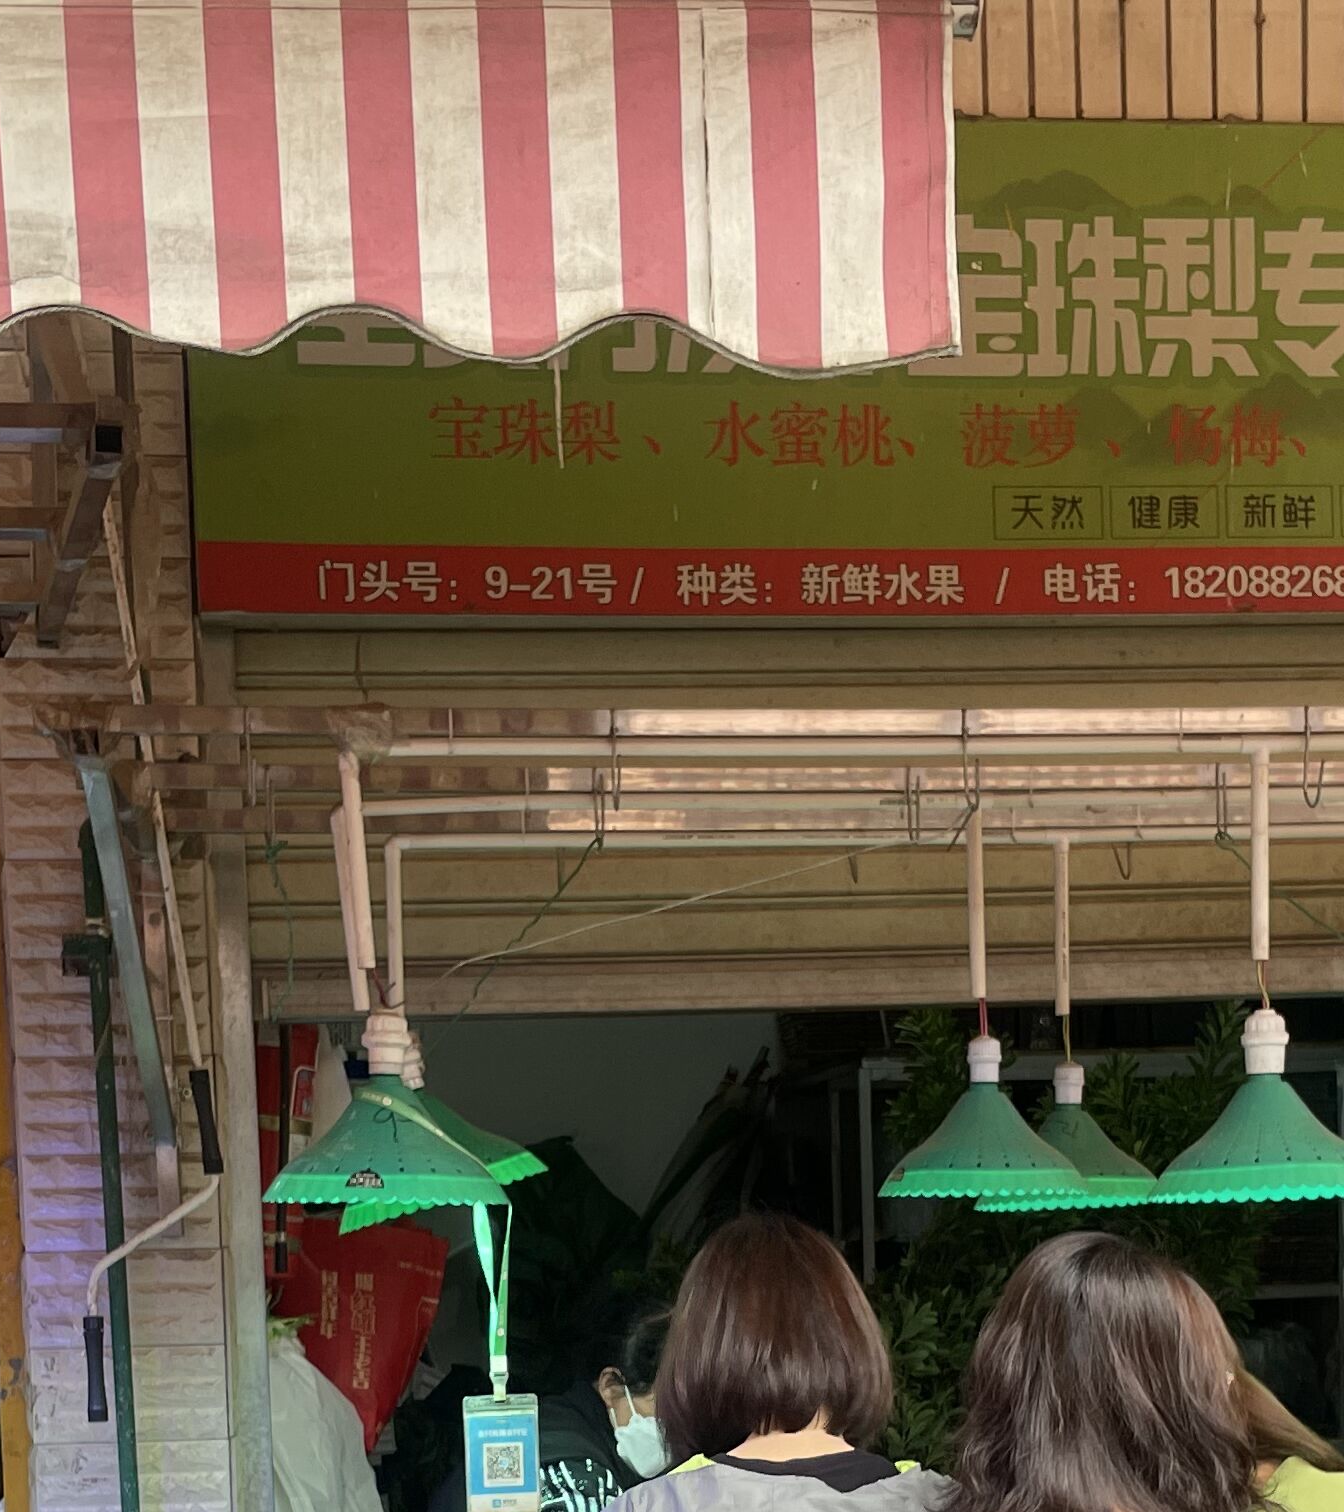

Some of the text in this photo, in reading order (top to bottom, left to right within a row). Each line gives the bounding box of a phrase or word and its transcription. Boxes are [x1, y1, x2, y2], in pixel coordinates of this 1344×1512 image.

[1010, 493, 1086, 531] 天然
[1127, 493, 1202, 531] 健康
[1242, 493, 1317, 531] 新鲜
[800, 562, 965, 606] 新鲜水果
